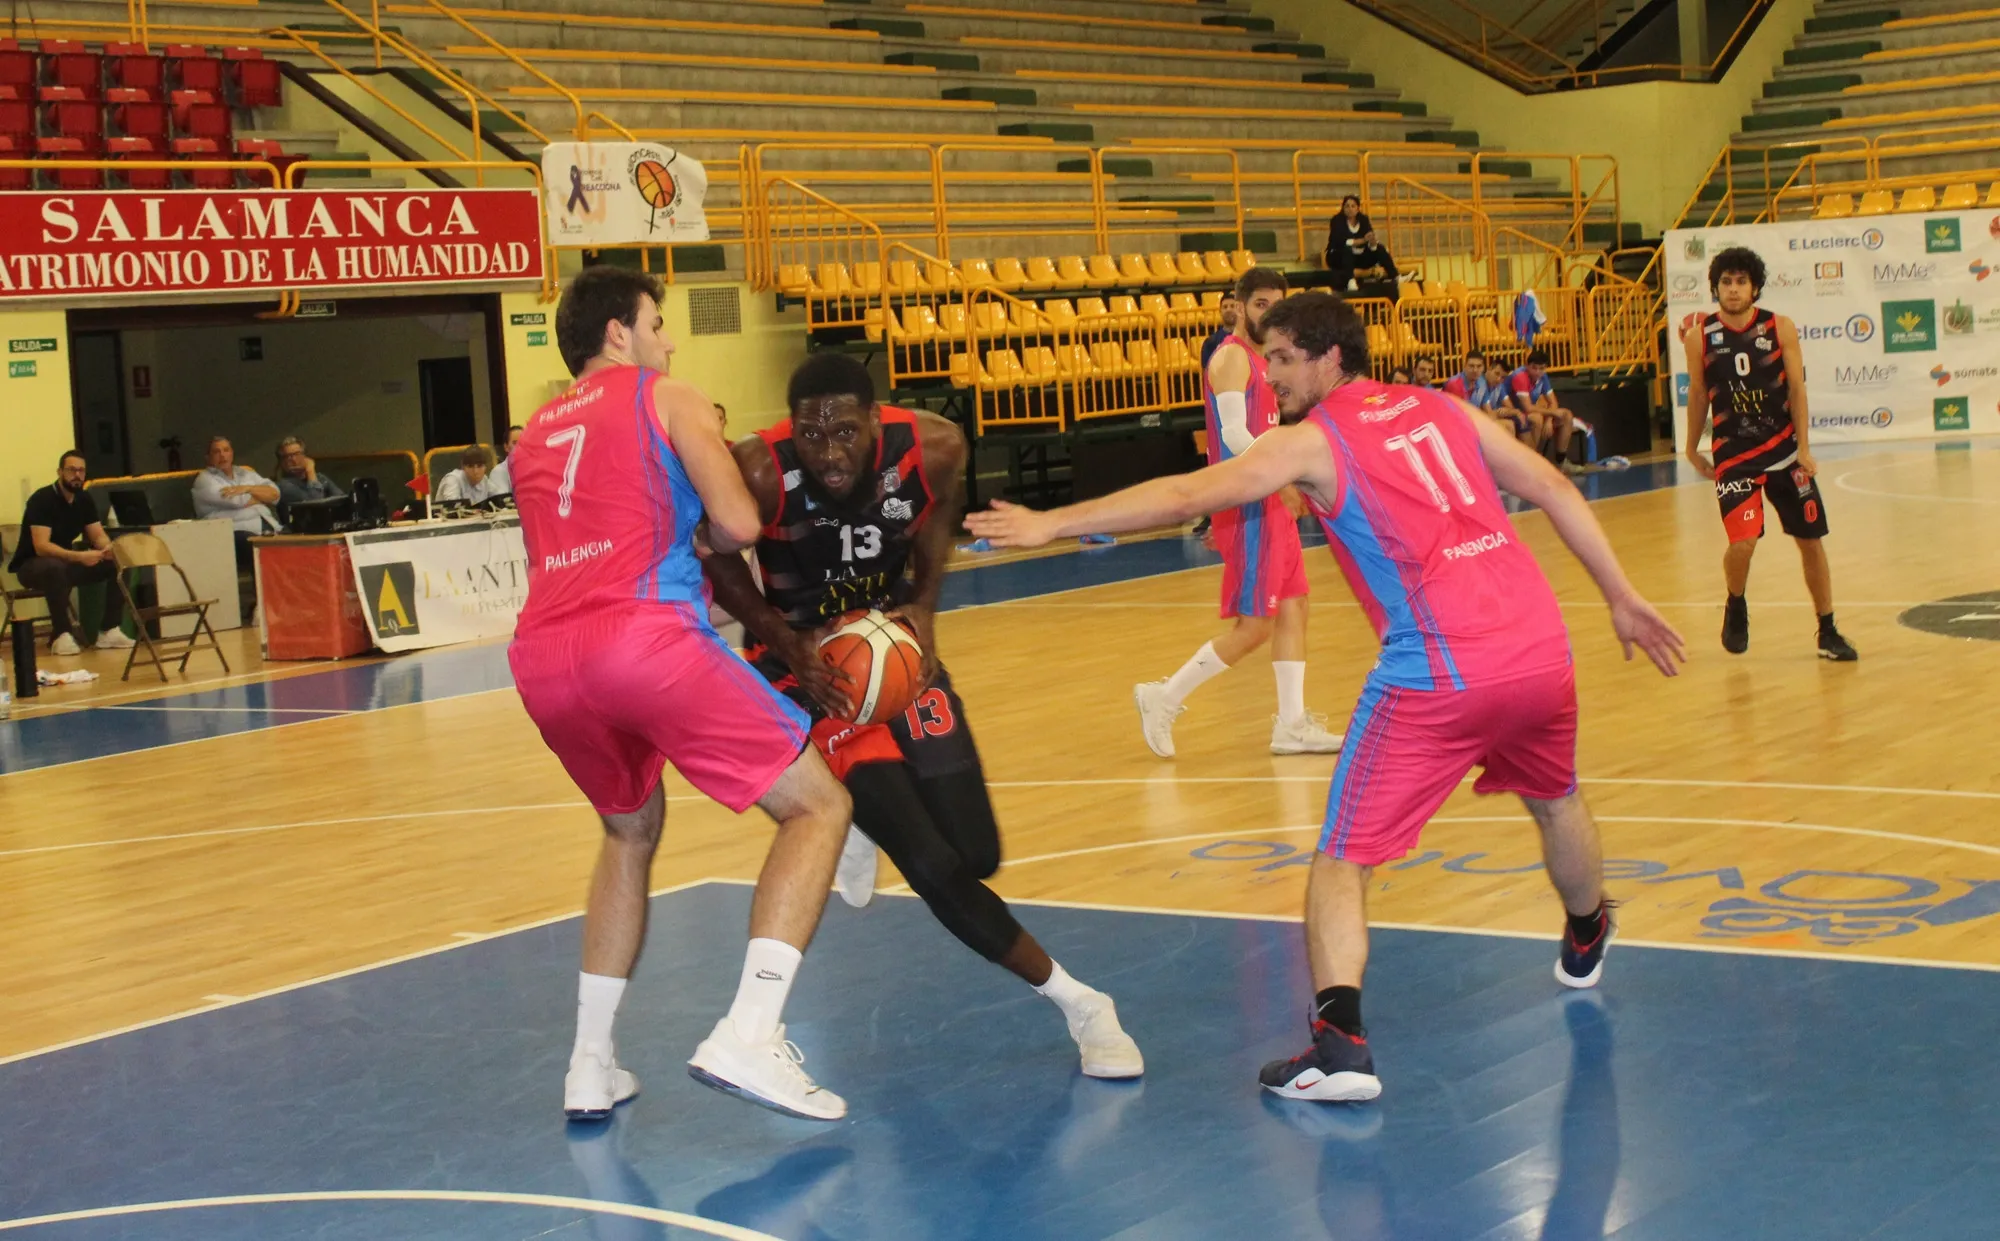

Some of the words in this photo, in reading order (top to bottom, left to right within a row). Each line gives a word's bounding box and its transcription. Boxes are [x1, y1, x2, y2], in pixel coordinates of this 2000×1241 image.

[41, 195, 480, 244] SALAMANCA
[1788, 234, 1860, 251] E.Leclerc
[220, 249, 273, 283] DE
[283, 247, 328, 282] LA
[335, 242, 530, 280] HUMANIDAD
[301, 303, 328, 314] SALIDA
[522, 314, 544, 324] SALIDA
[12, 341, 41, 351] SALIDA
[1734, 352, 1751, 376] 0
[539, 386, 605, 424] FILIPENSES
[1811, 412, 1869, 429] Leclerc
[545, 424, 587, 519] 7
[1384, 421, 1477, 514] 11
[1803, 499, 1818, 524] 0
[545, 538, 614, 573] PALENCIA
[839, 524, 883, 562] 13
[1442, 531, 1509, 561] PALENCIA
[824, 566, 856, 582] LA
[904, 687, 954, 741] 13
